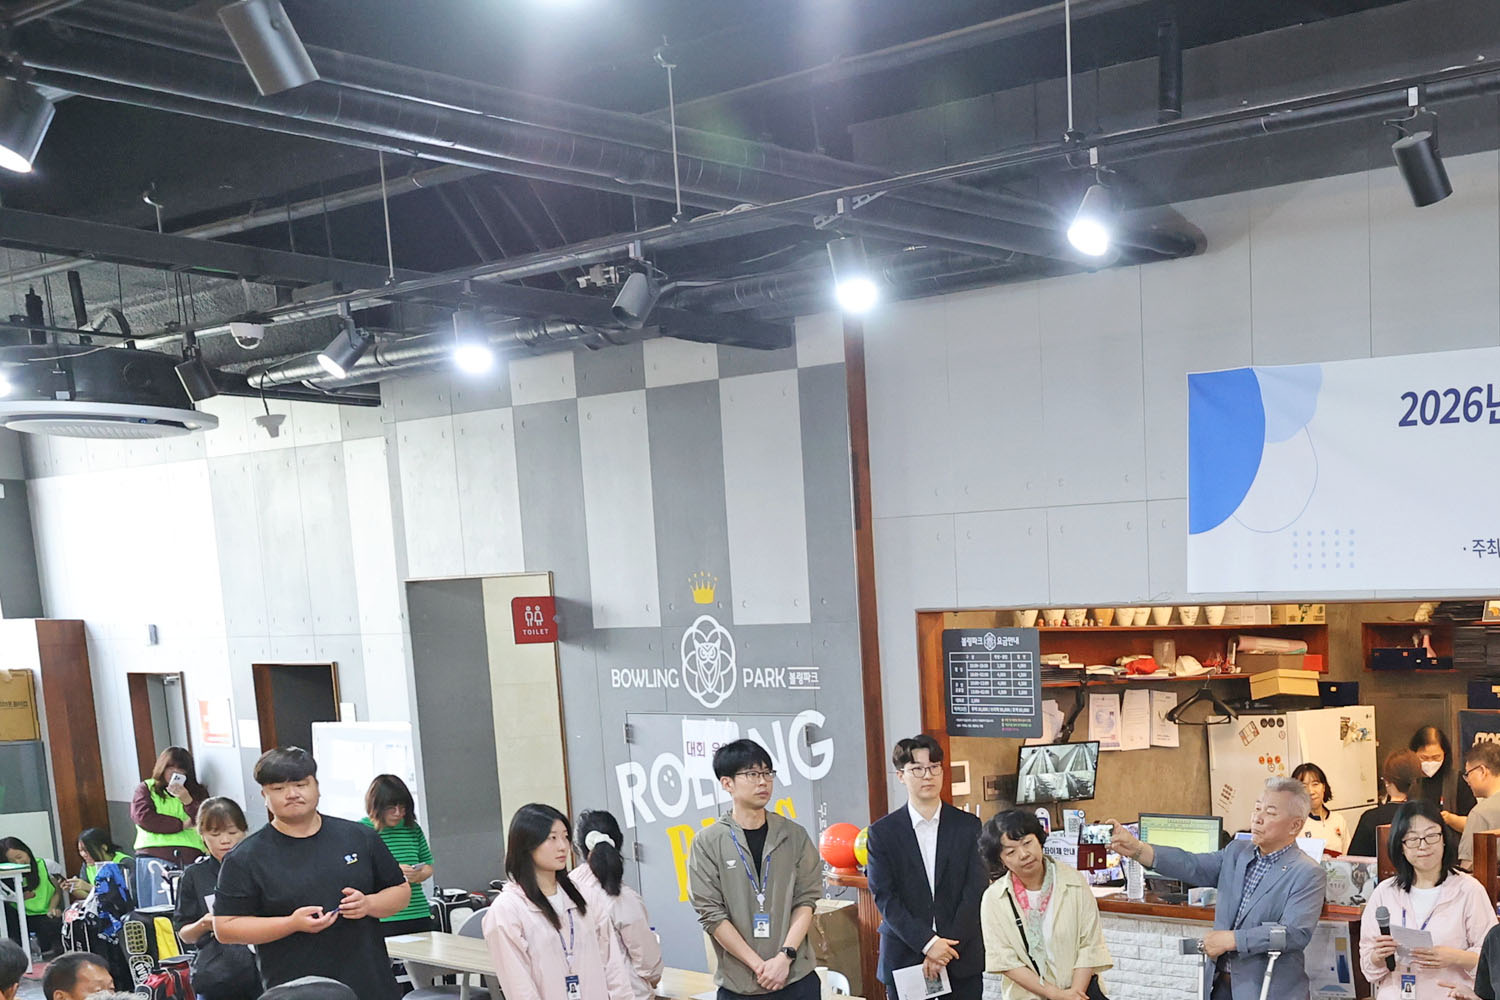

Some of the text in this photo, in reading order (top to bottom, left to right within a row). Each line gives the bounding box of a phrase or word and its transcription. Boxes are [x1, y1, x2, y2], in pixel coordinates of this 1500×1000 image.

[522, 628, 549, 636] TOILET
[611, 667, 787, 688] BOWLING PARK
[788, 671, 819, 685] 볼링파크
[686, 741, 706, 757] 대회
[615, 709, 835, 829] ROLNG
[1063, 847, 1075, 856] 안내
